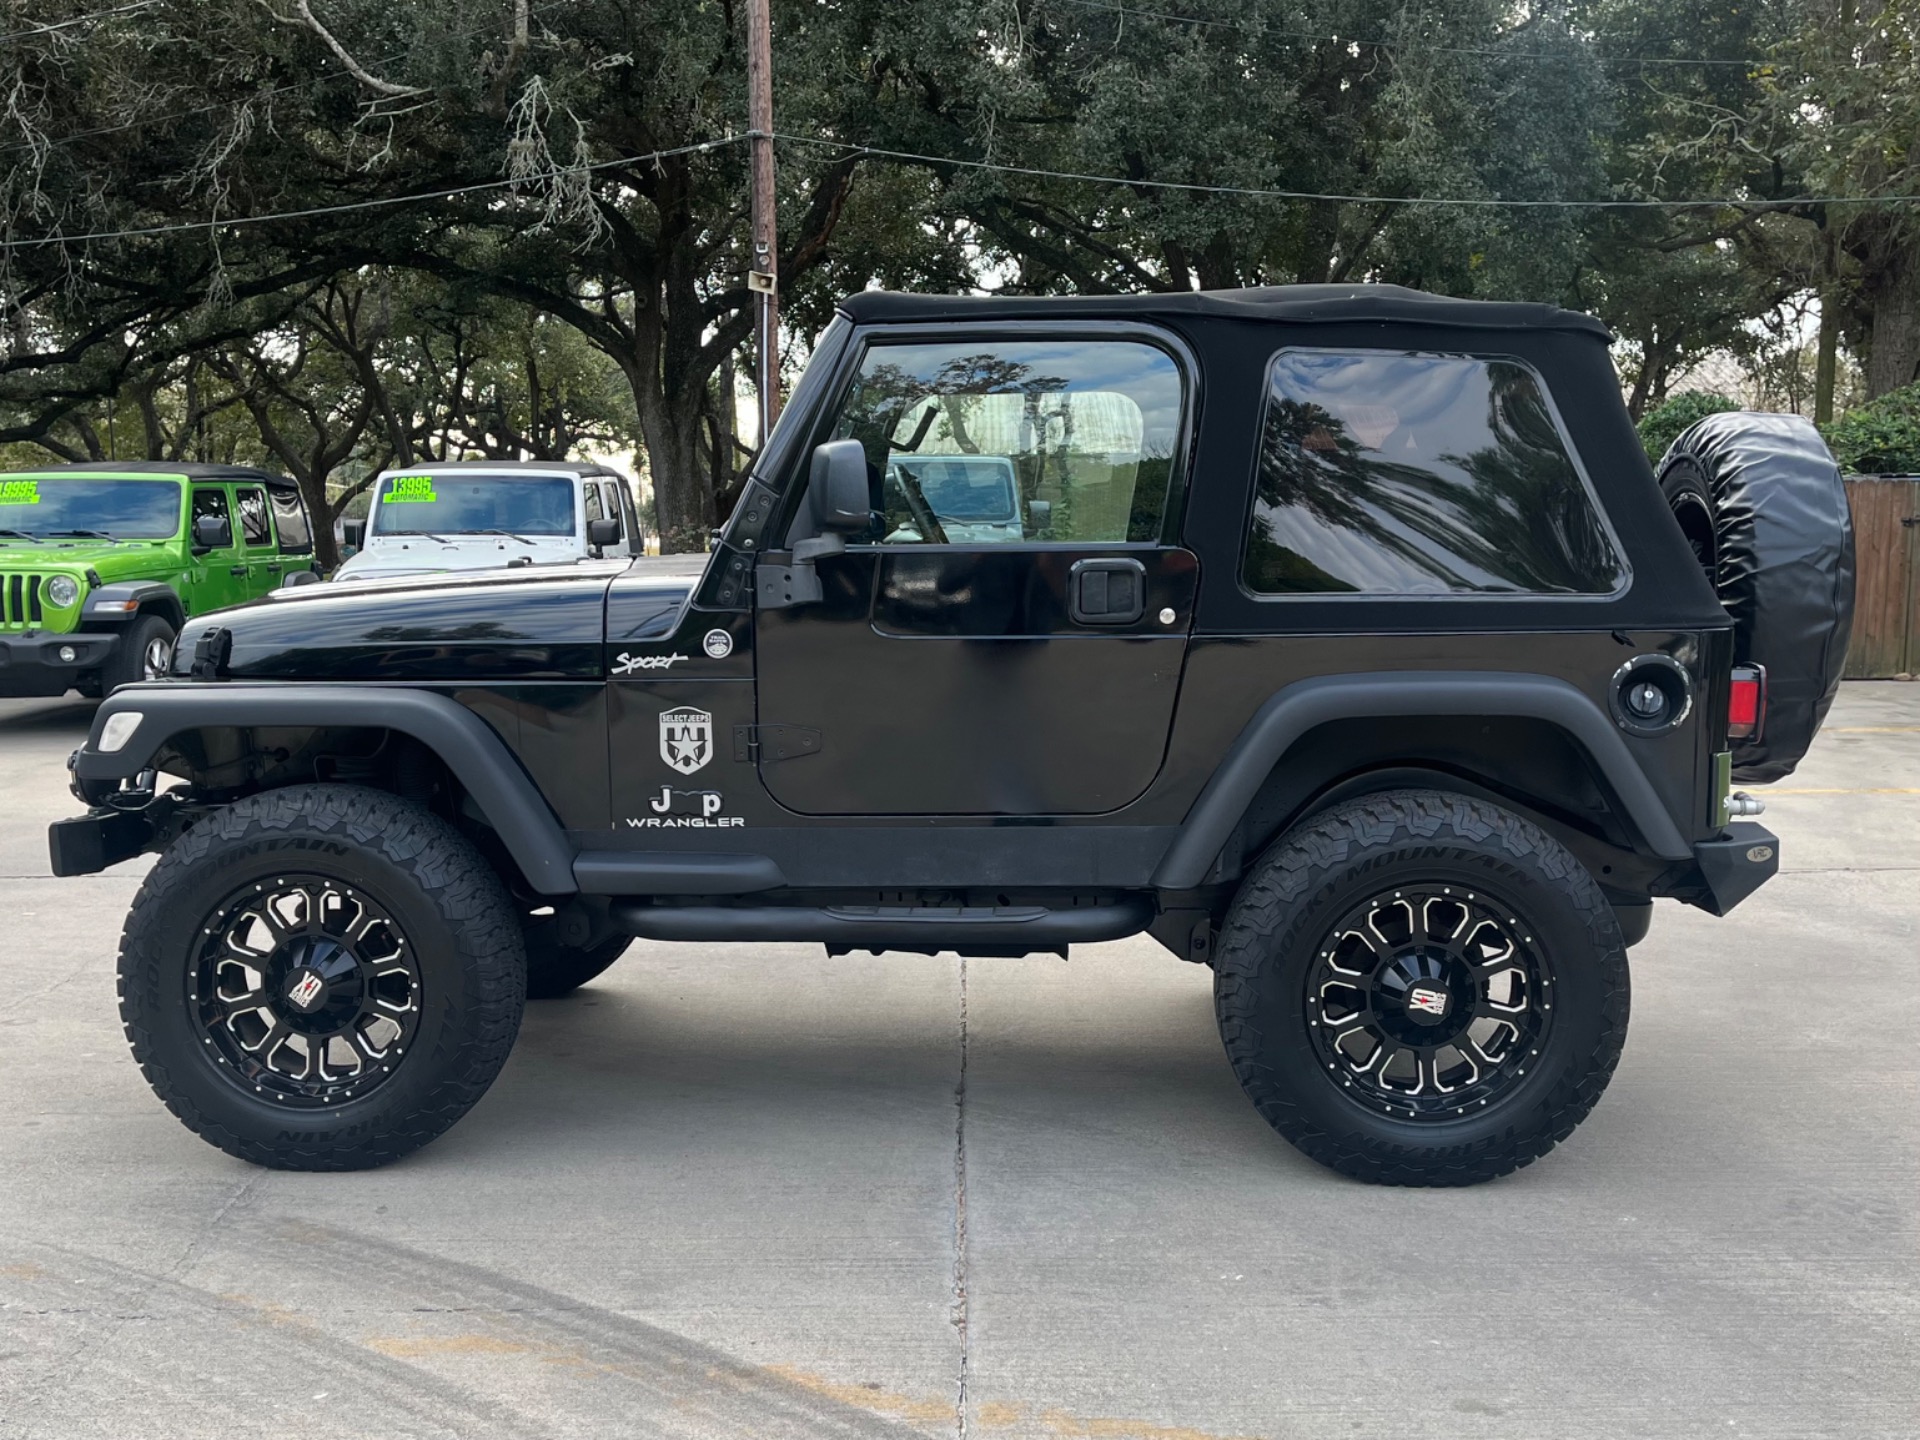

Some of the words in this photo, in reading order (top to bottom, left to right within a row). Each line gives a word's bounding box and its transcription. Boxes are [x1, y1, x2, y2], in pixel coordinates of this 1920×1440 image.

[392, 476, 432, 493] 13995
[390, 493, 429, 501] AUTOMATIC
[611, 652, 688, 674] Sport
[662, 714, 687, 722] SELECT
[687, 714, 710, 722] JEEPS
[651, 788, 721, 816] Jp
[626, 817, 744, 827] WRANGLER
[1346, 844, 1537, 887] MOUNTAIN
